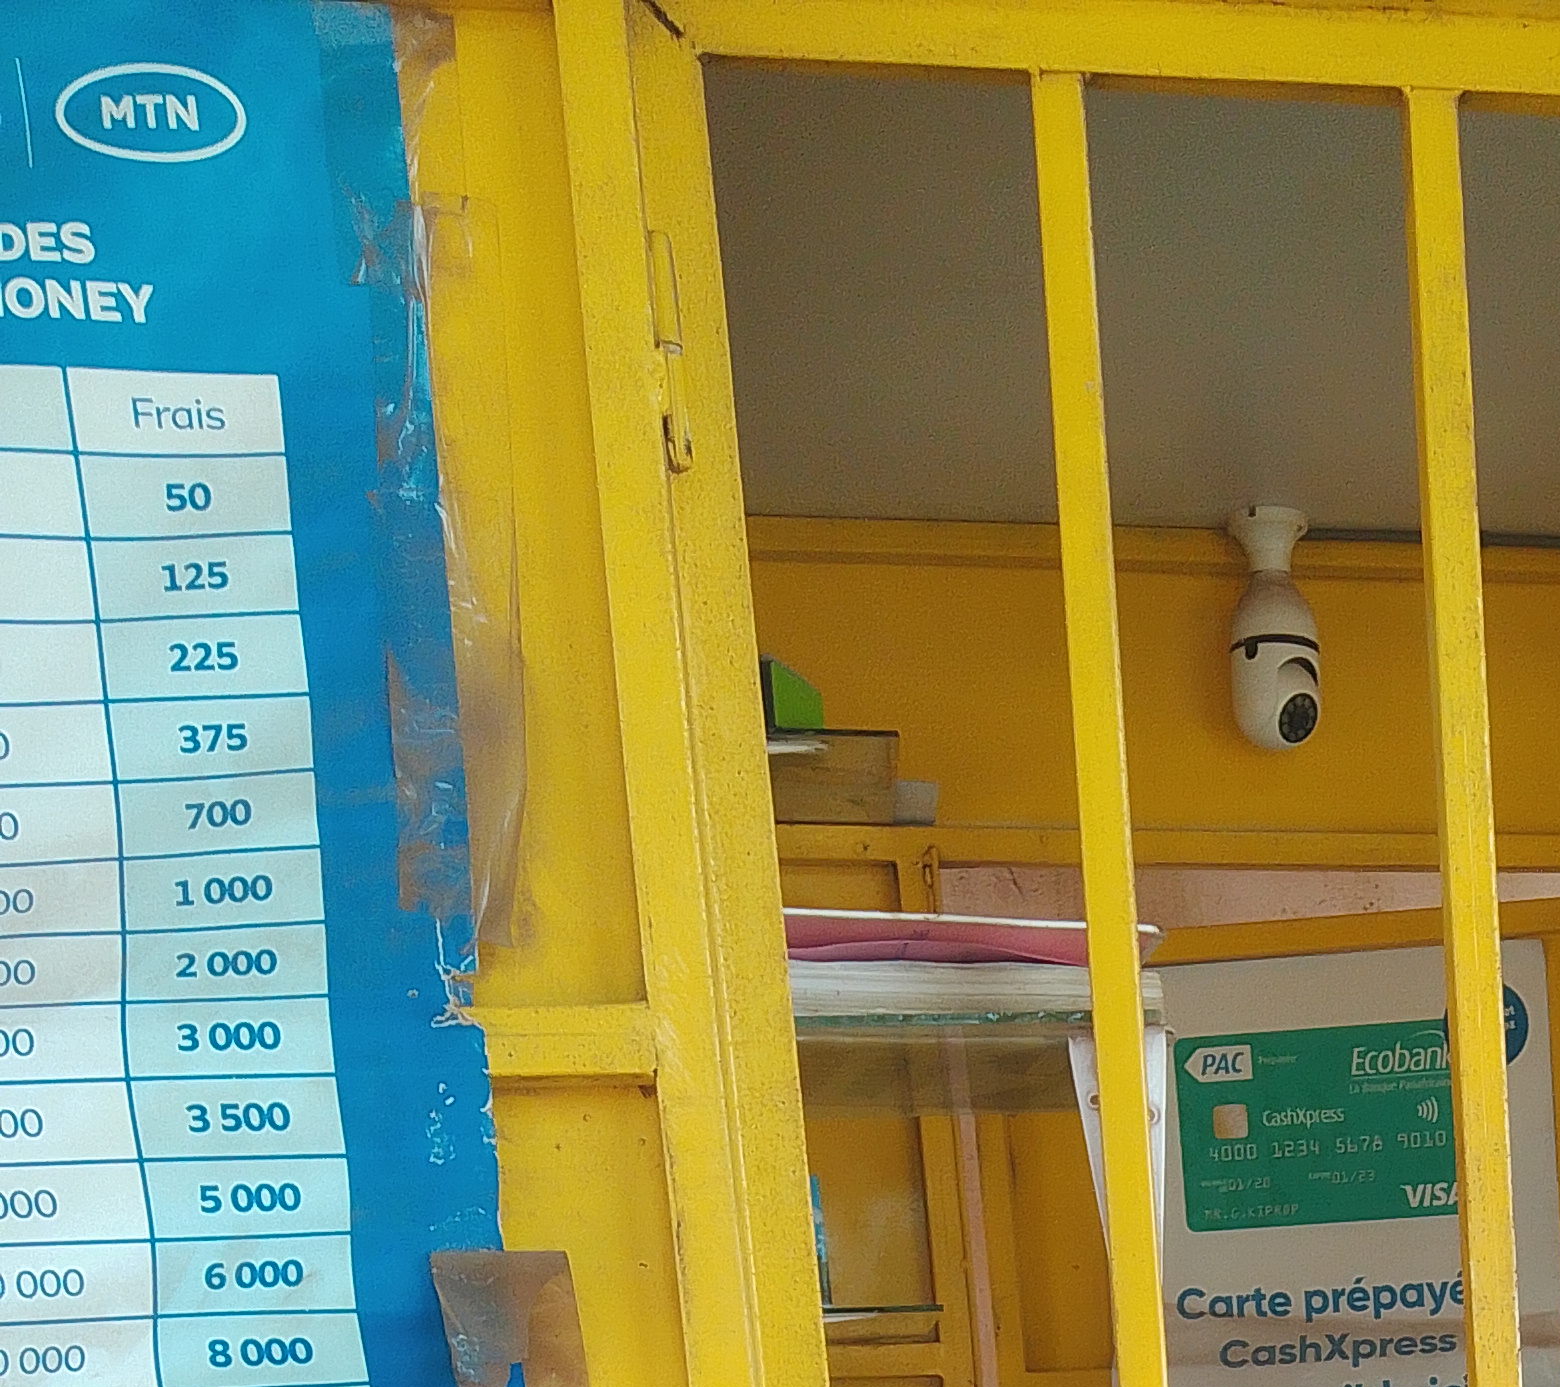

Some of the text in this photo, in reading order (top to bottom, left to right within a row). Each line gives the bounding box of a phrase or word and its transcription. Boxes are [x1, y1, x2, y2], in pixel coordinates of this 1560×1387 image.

[100, 93, 201, 133] MTN
[0, 221, 96, 264] DES
[0, 276, 154, 324] ONEY
[131, 397, 227, 432] Frais
[165, 484, 212, 512] 50
[161, 561, 230, 593] 125
[168, 641, 240, 673] 225
[177, 722, 249, 754] 375
[184, 798, 252, 830] 700
[1200, 1051, 1245, 1077] PAC
[1262, 1106, 1345, 1130] CashXpress
[1209, 1131, 1447, 1162] 4000 1234 5678 9010
[1176, 1286, 1293, 1321] Carte
[1218, 1332, 1458, 1369] CashXpress
